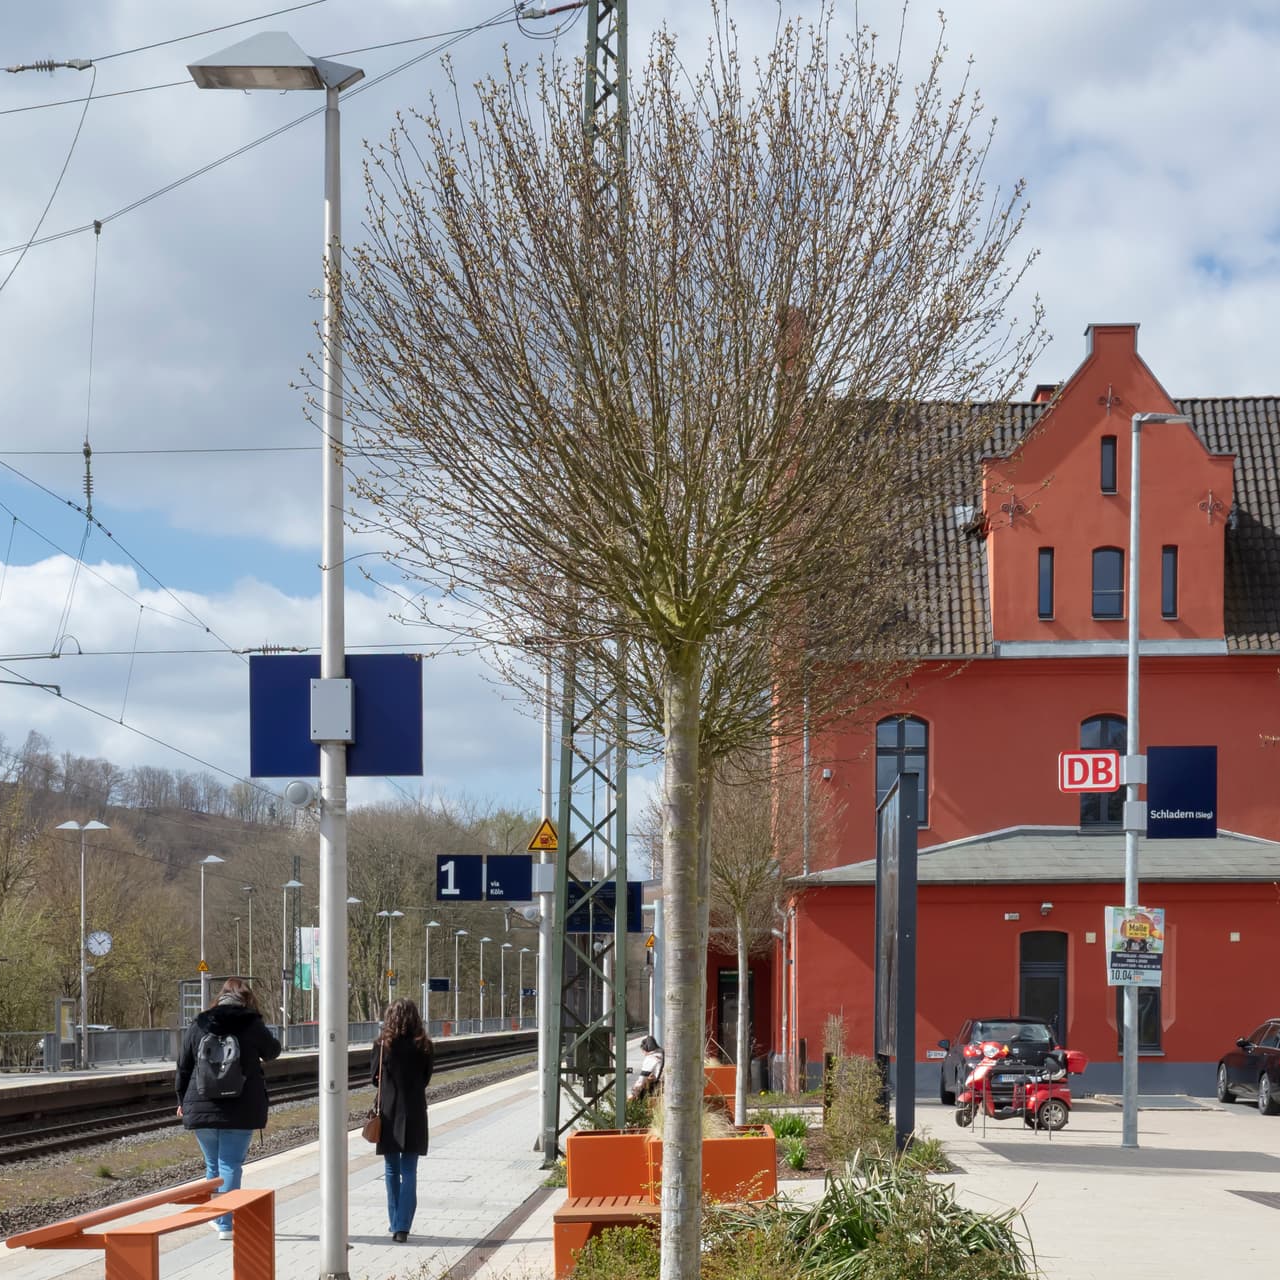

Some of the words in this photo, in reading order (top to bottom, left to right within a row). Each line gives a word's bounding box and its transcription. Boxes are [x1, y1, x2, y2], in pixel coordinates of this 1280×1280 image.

[1068, 757, 1113, 785] DB
[1150, 809, 1195, 819] Schladern
[1195, 811, 1213, 820] (Sieg)
[441, 861, 460, 895] 1
